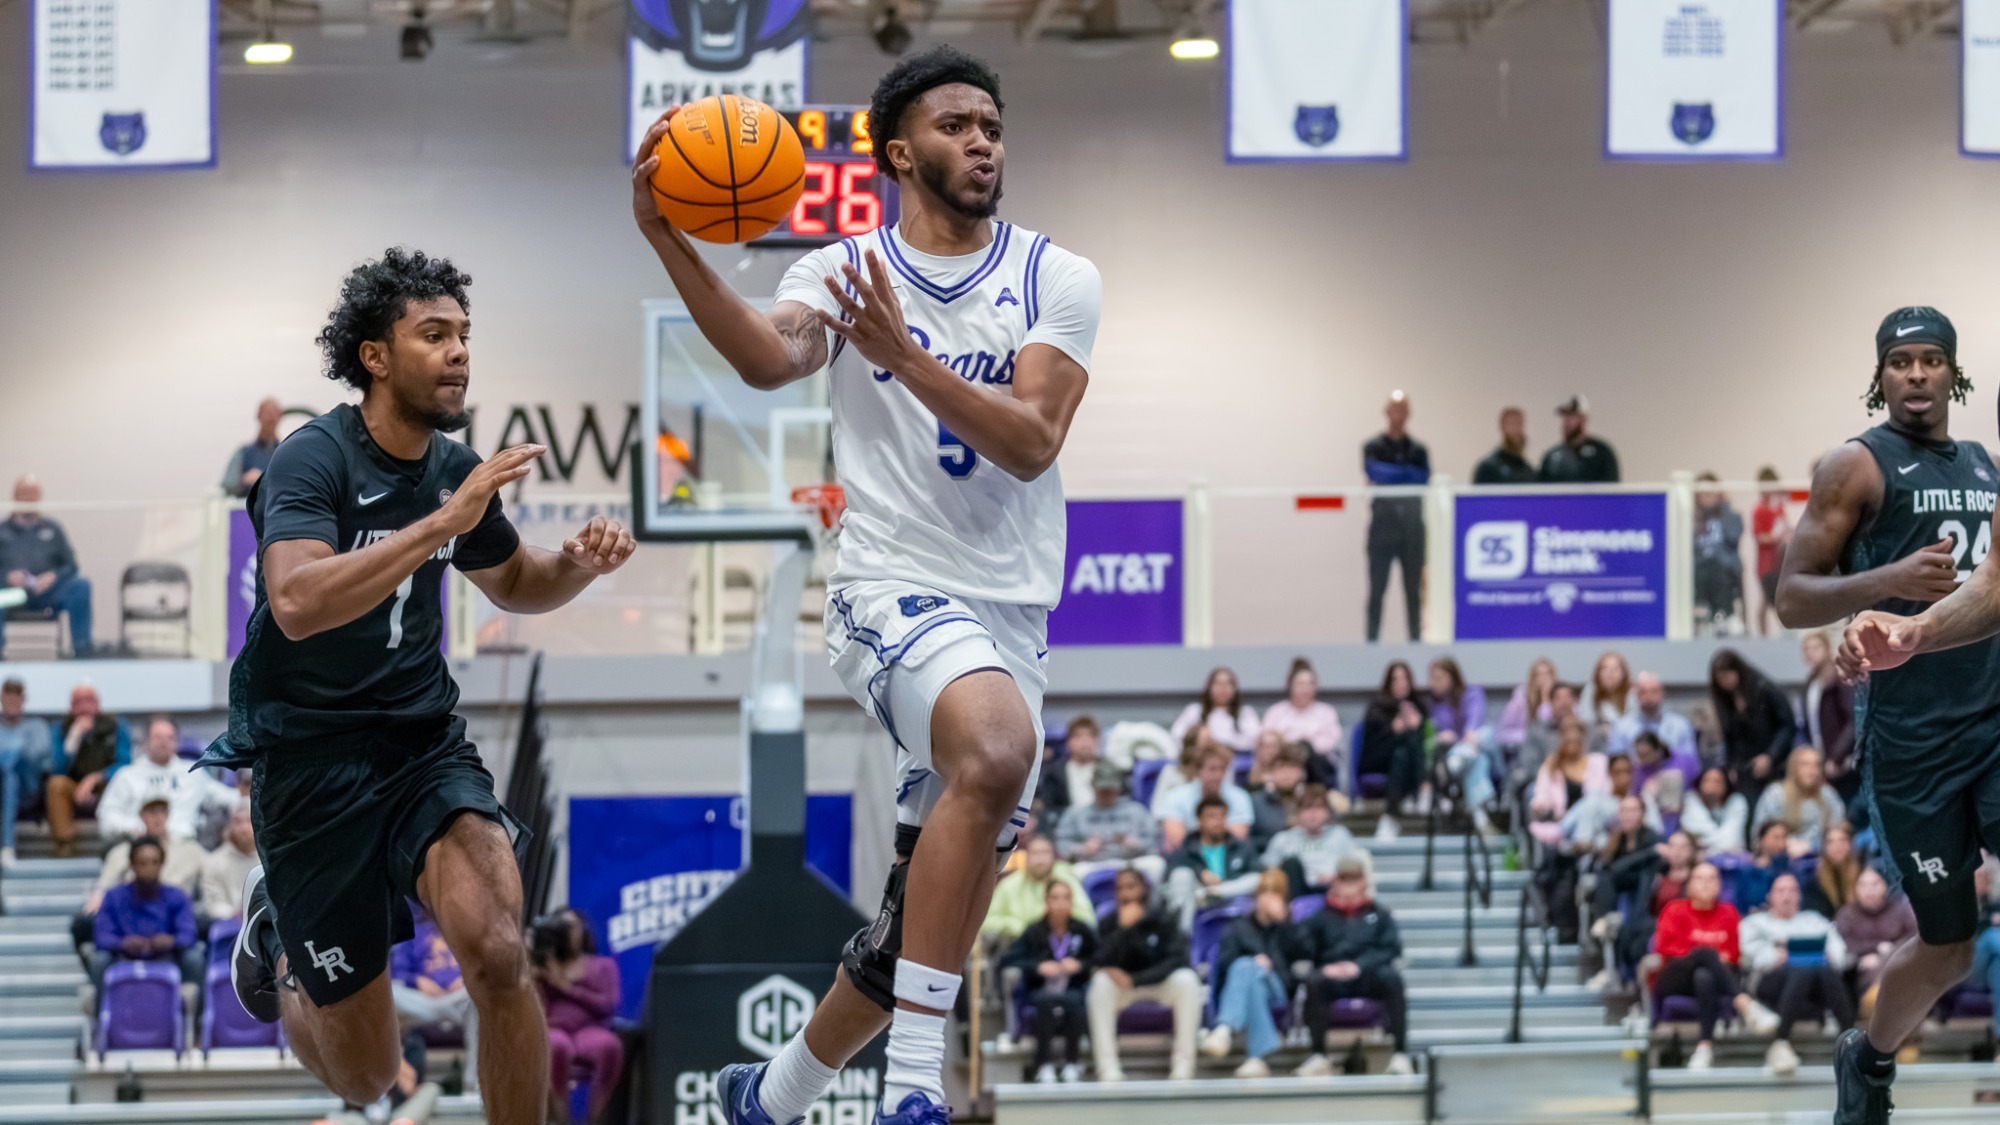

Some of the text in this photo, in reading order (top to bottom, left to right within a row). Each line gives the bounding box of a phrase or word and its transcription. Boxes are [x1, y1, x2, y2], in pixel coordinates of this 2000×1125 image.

[789, 161, 881, 236] 26
[1913, 489, 1962, 513] LITTLE
[1533, 526, 1653, 552] Simmons
[1938, 520, 1991, 583] 24
[1070, 553, 1173, 594] AT&T
[1911, 851, 1949, 884] LR
[620, 869, 738, 912] CENT
[304, 940, 354, 982] LR
